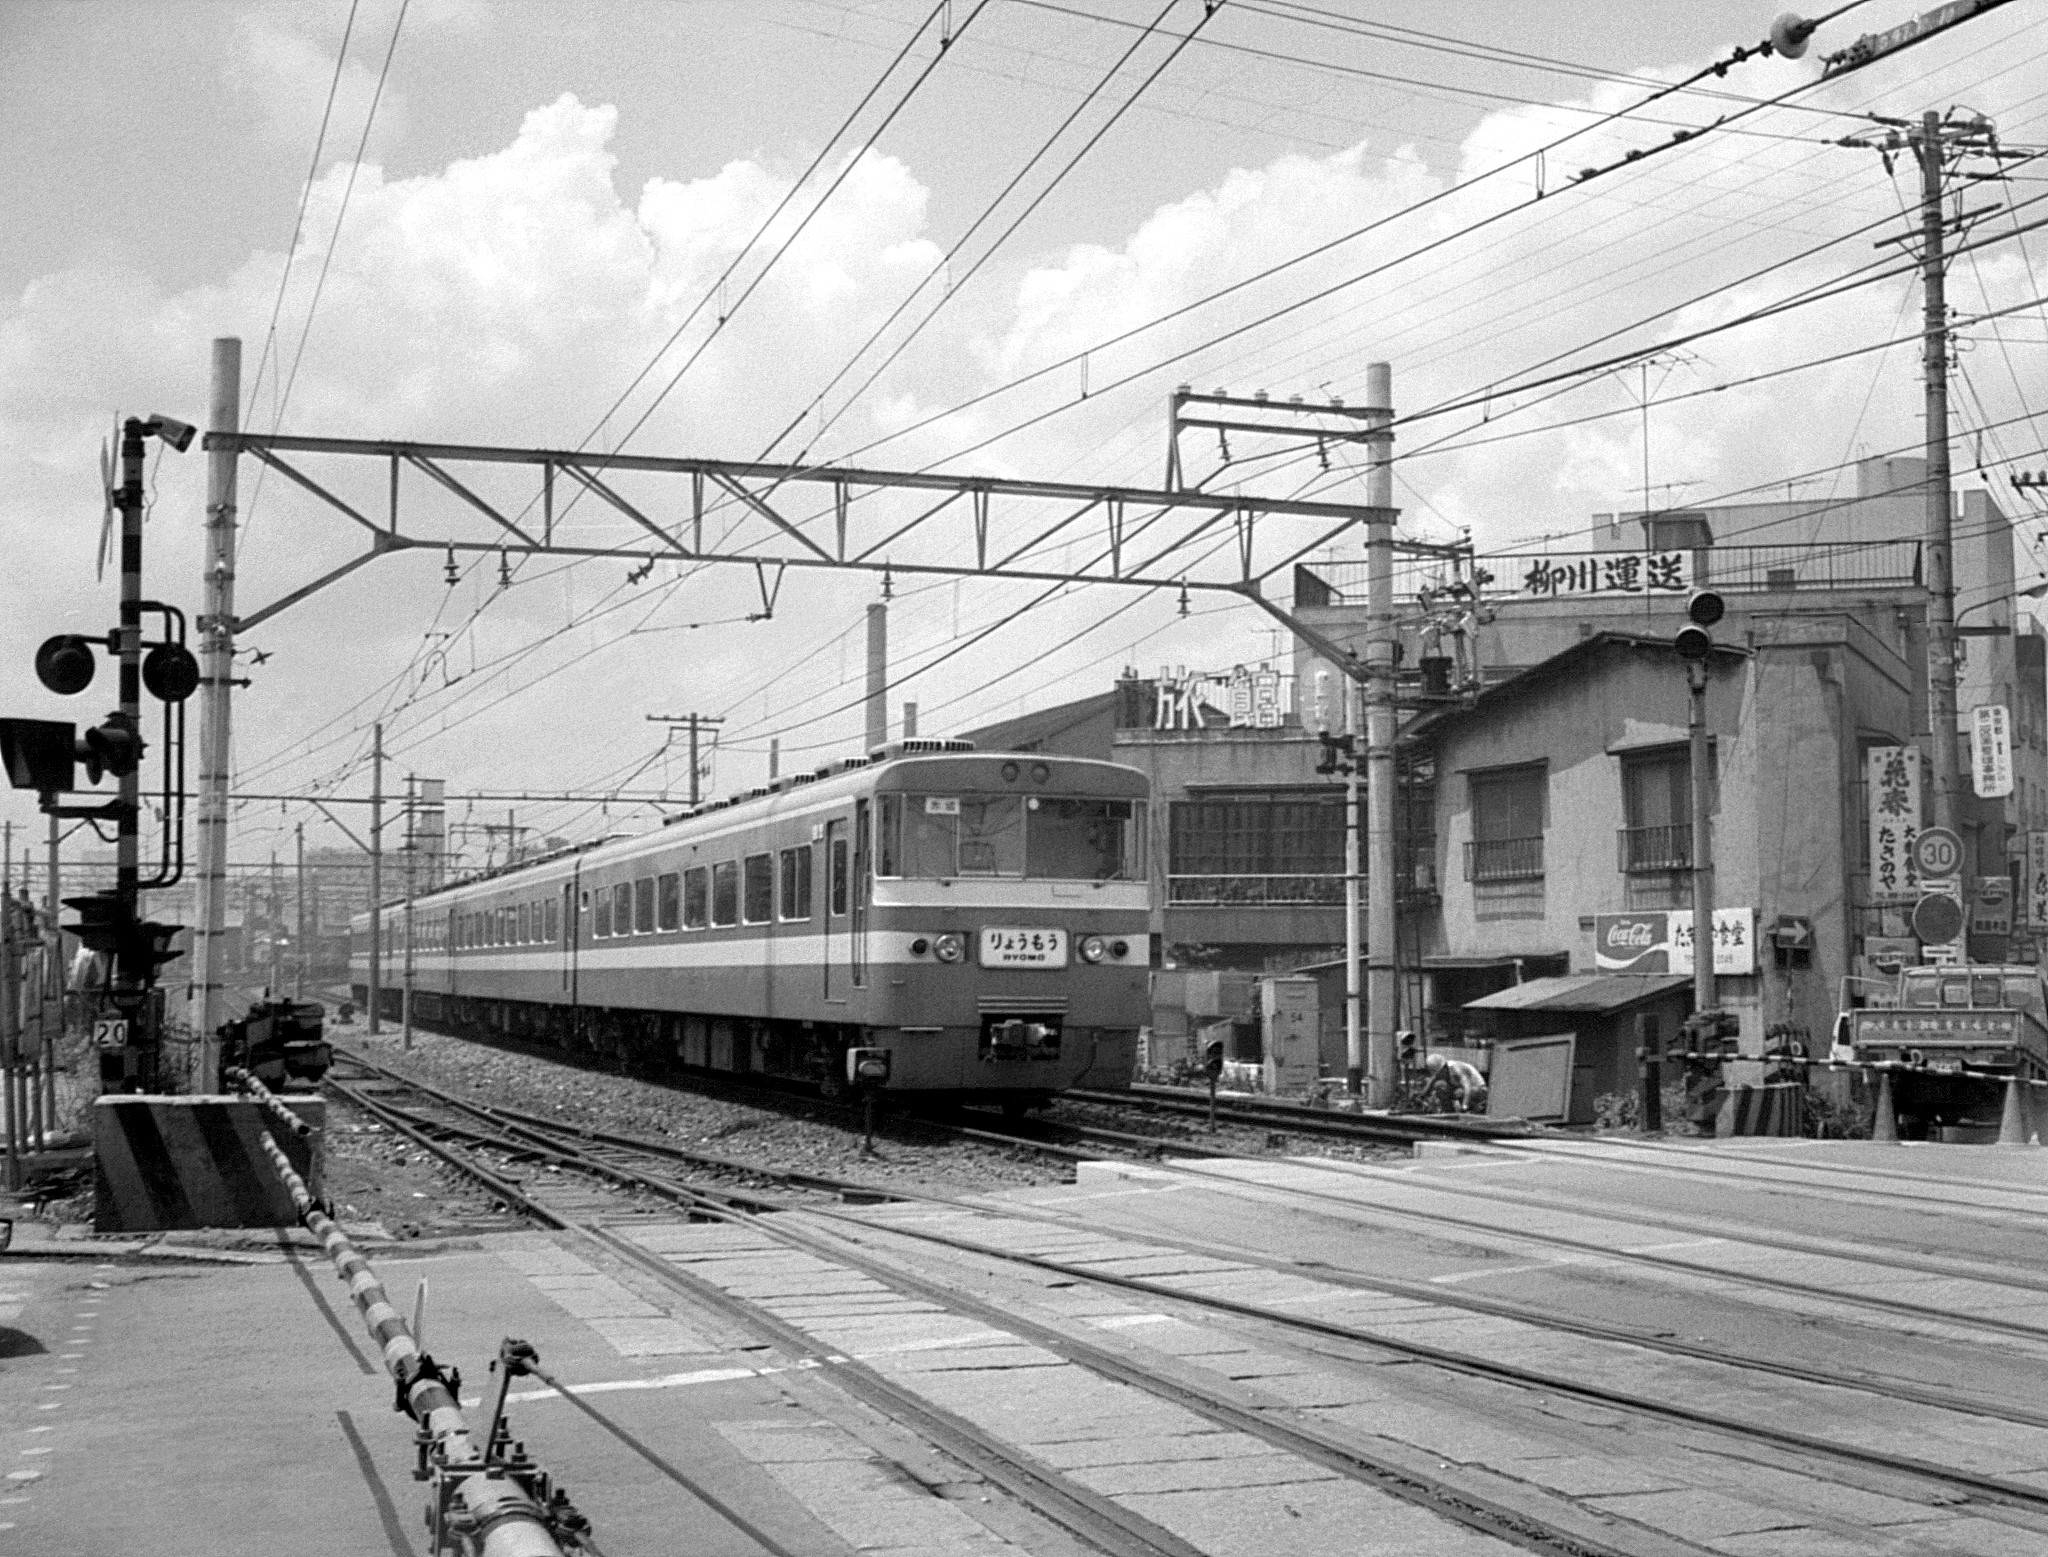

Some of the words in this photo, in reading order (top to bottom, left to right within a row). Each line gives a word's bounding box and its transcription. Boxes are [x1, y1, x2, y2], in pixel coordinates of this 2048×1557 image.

[1524, 553, 1689, 596] 柳川運送
[1923, 842, 1952, 866] 30
[990, 932, 1058, 951] りょうもう
[1003, 953, 1046, 961] RYOMO
[97, 1022, 125, 1044] 20
